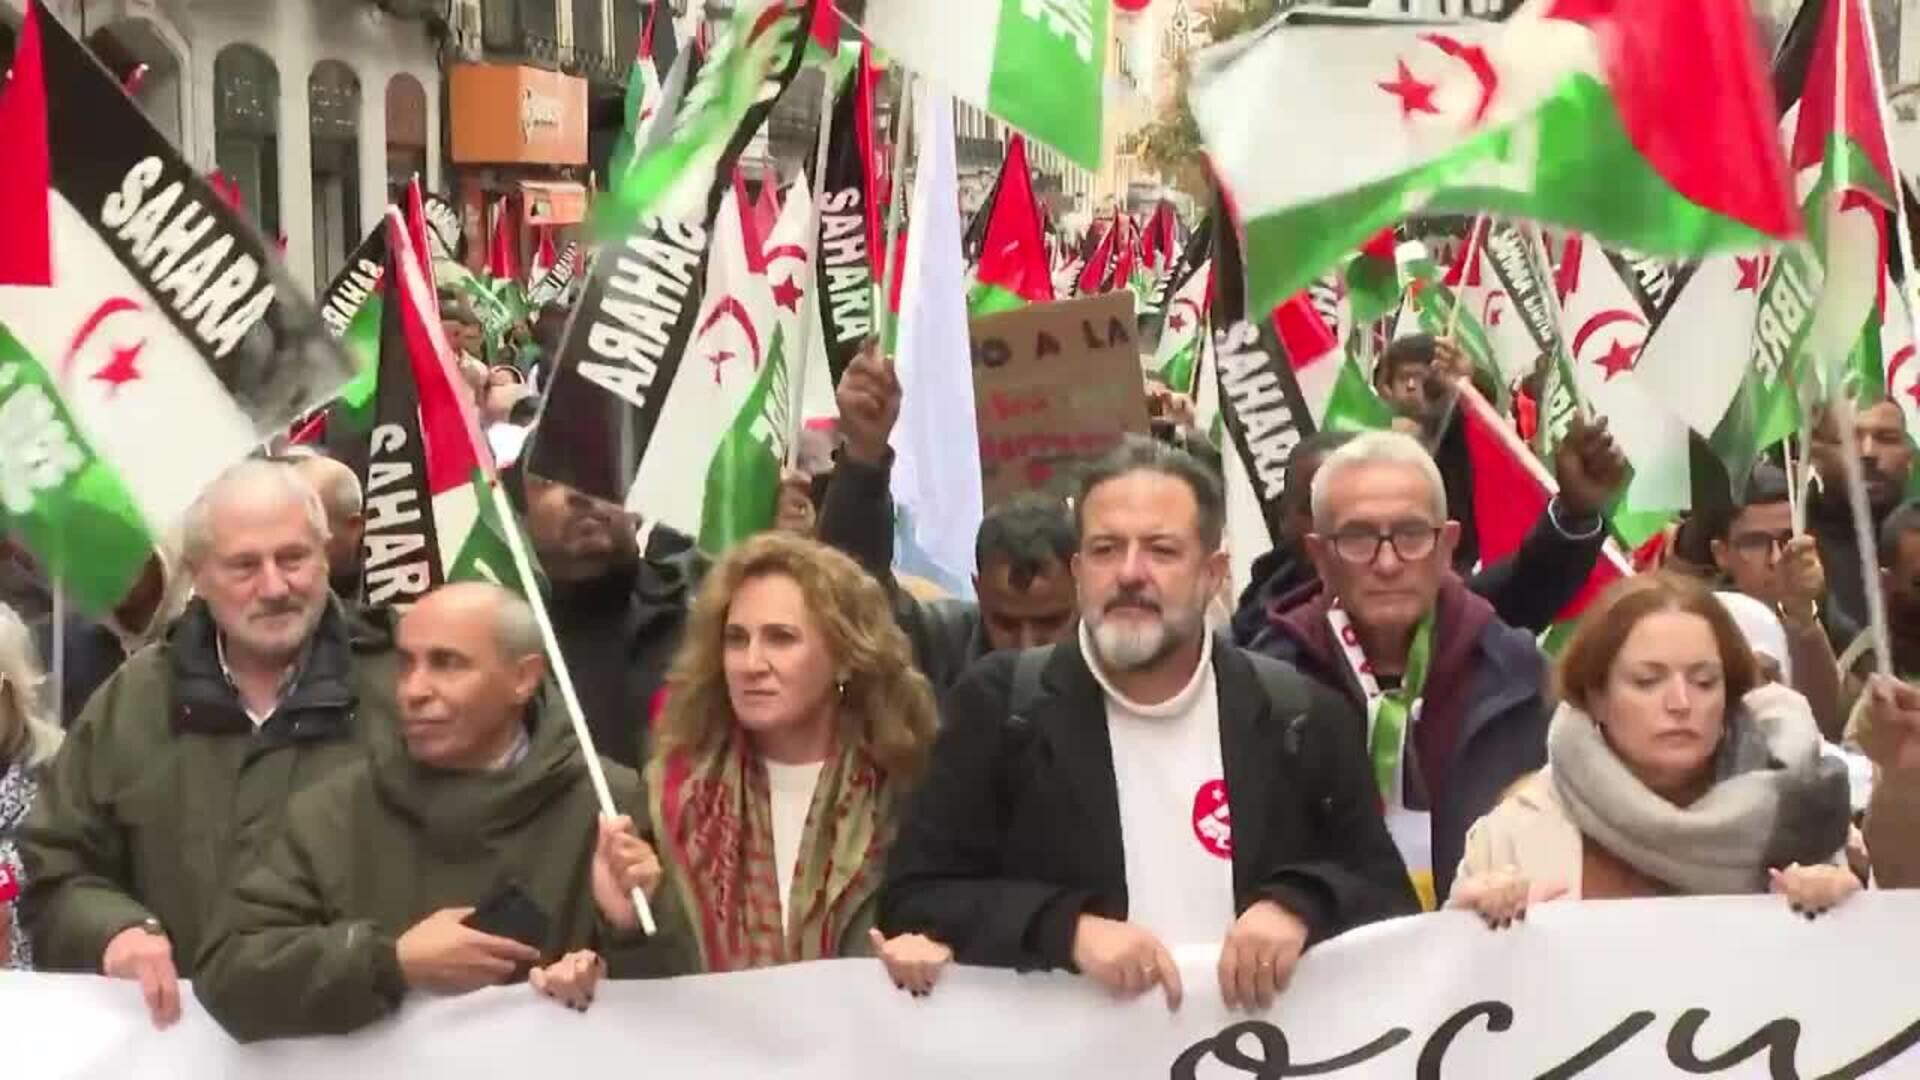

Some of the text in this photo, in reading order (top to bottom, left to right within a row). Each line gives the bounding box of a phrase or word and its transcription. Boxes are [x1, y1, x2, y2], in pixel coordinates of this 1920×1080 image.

[101, 155, 276, 360] SAHARA
[820, 187, 871, 343] SAHARA
[1036, 330, 1060, 360] A
[1083, 316, 1129, 349] LA
[363, 423, 432, 606] SAHAR
